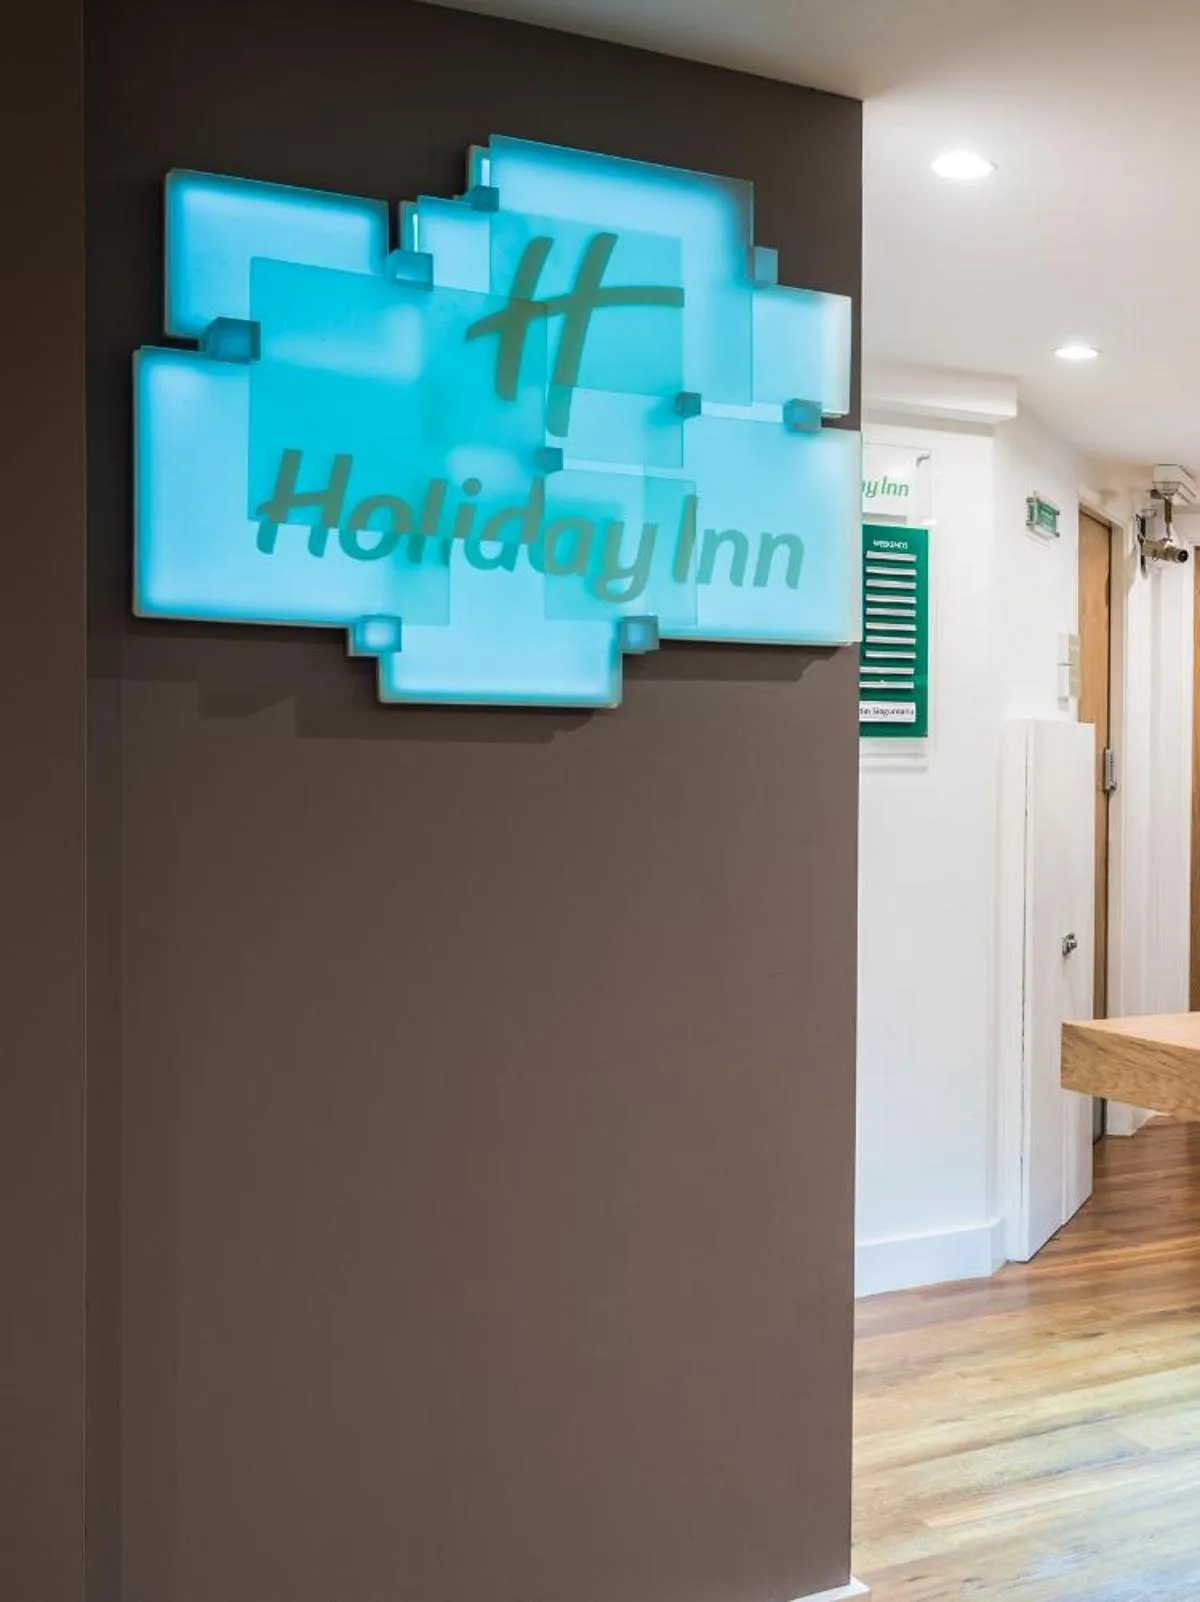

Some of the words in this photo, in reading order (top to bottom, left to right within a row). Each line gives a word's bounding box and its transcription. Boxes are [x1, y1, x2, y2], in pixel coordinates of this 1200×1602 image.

[465, 231, 685, 438] H
[255, 447, 658, 603] Holiday
[672, 494, 805, 590] Inn
[881, 474, 909, 497] Inn
